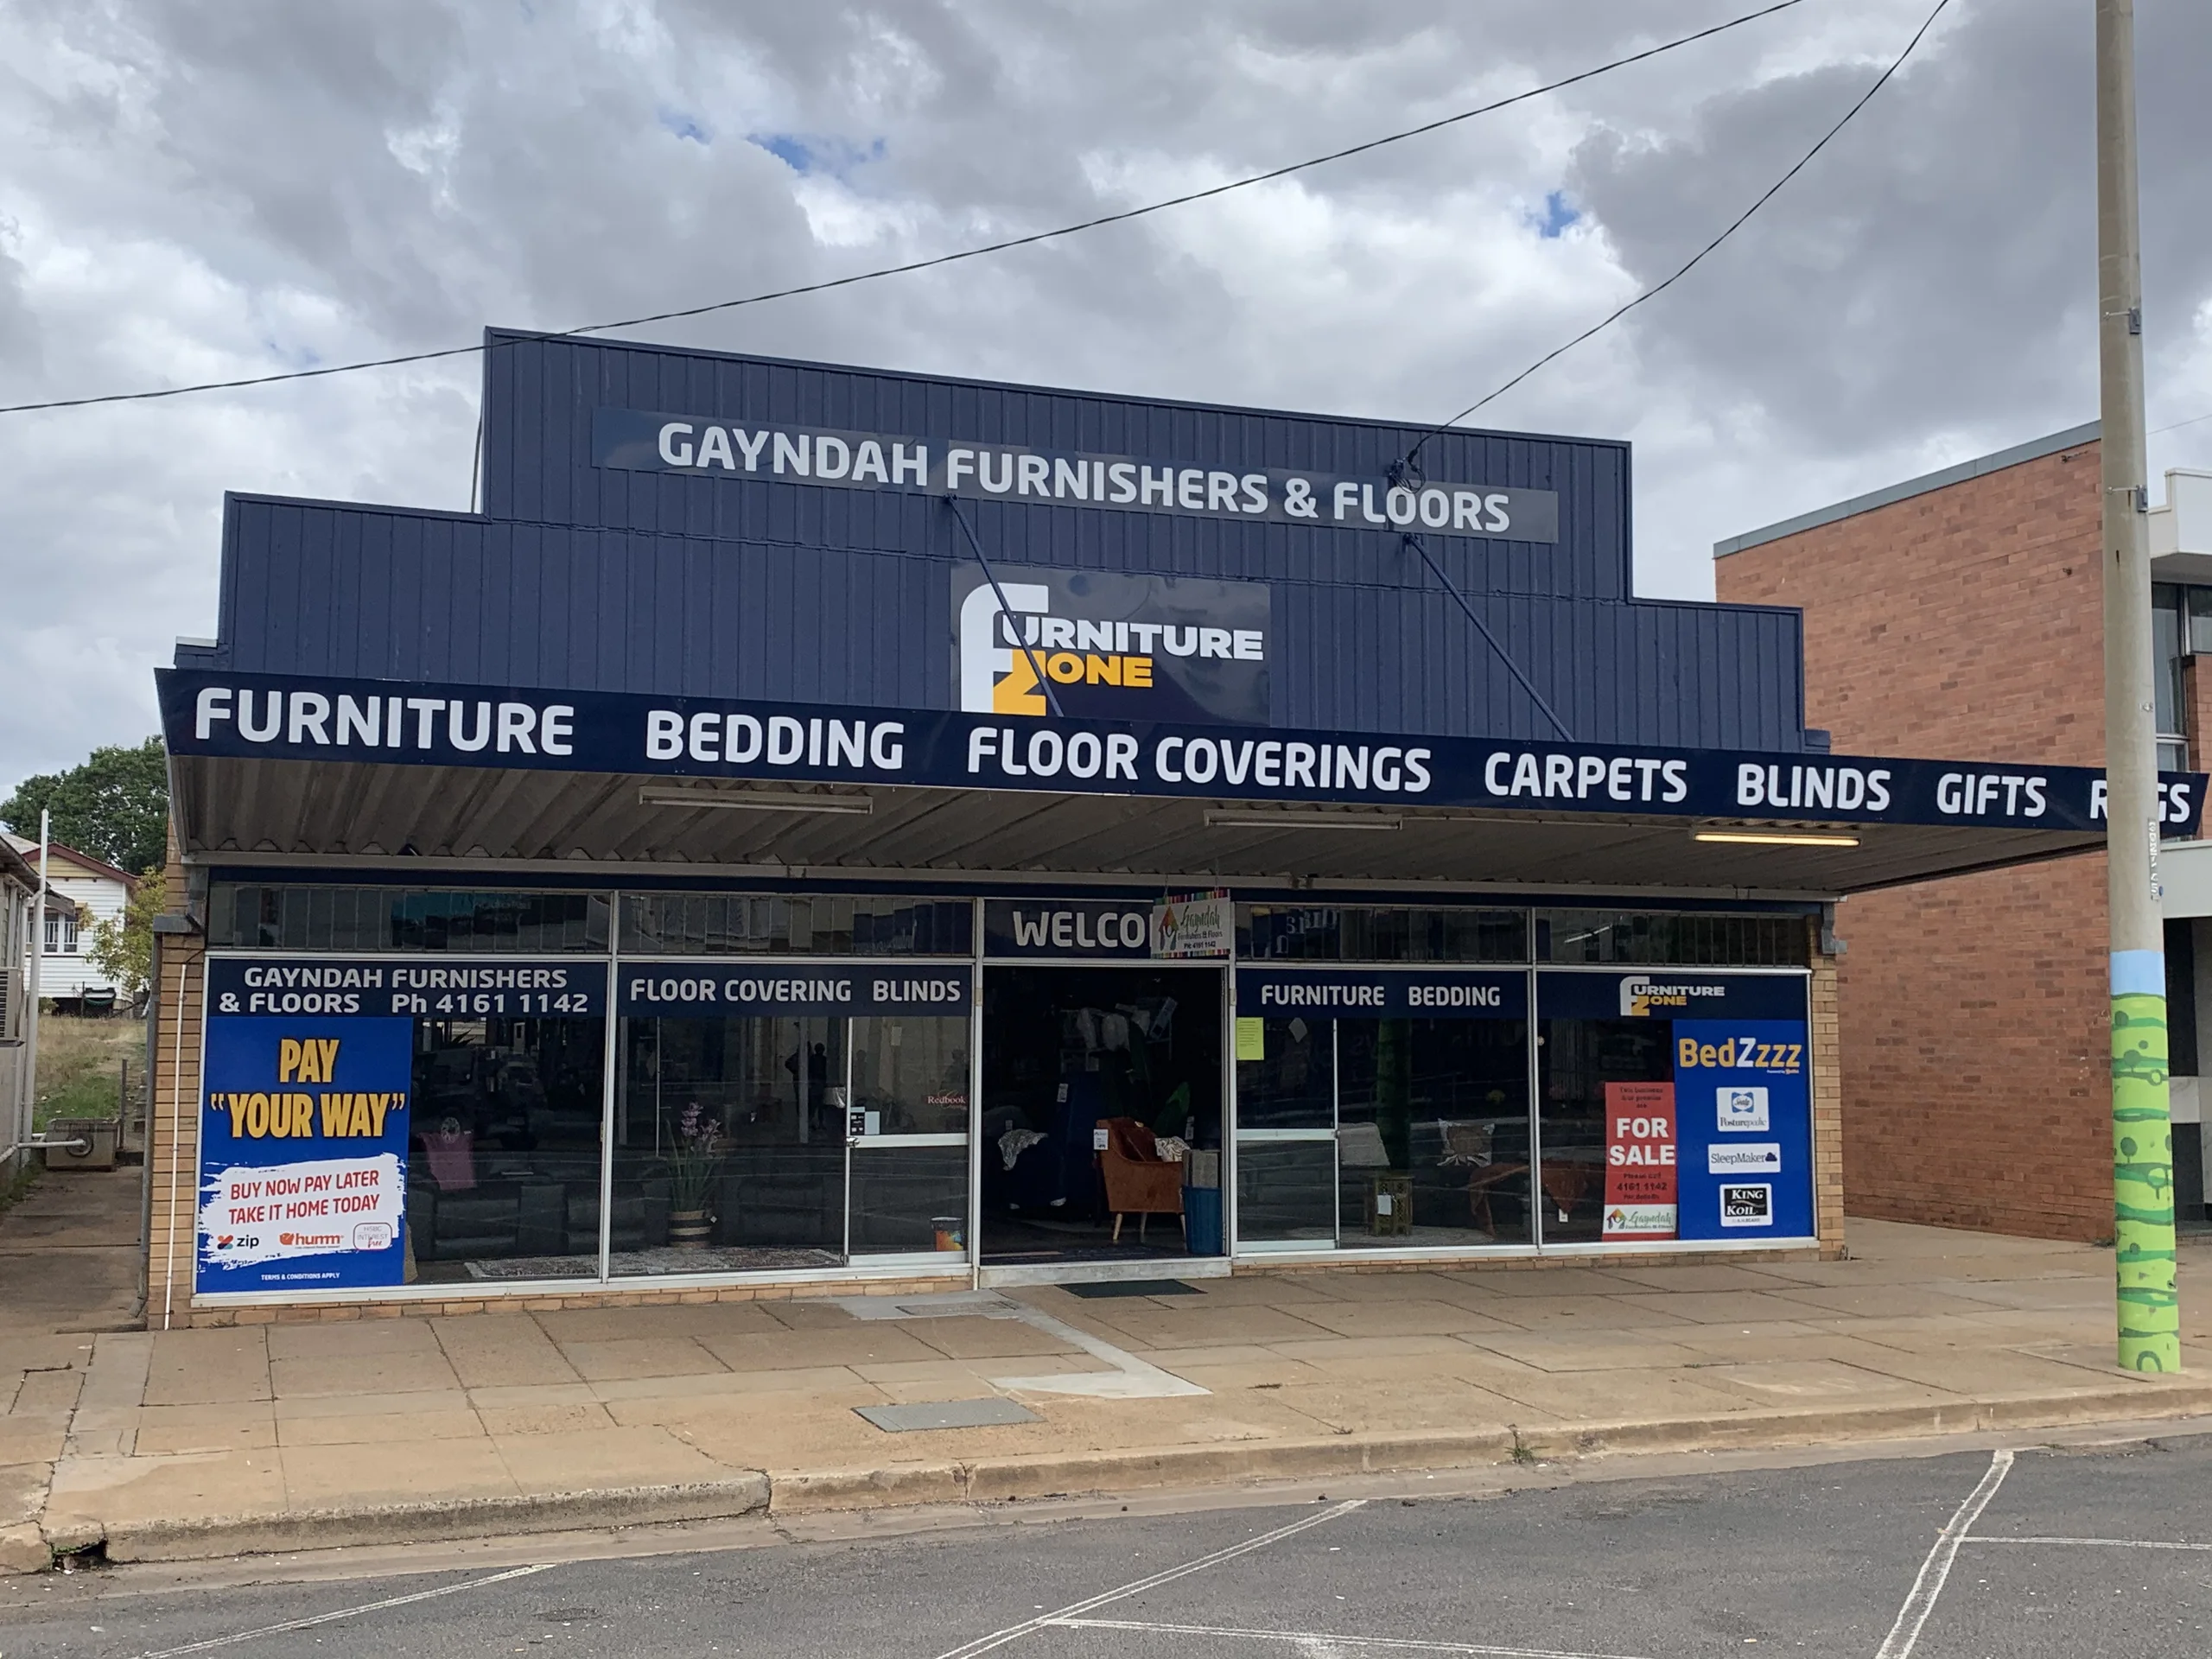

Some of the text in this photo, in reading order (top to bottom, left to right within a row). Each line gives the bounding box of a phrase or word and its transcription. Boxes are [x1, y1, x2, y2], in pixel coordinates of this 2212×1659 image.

[658, 423, 1511, 533] GAYNDAH FURNISHERS & FLOORS
[960, 582, 1263, 714] FURNITURE
[993, 648, 1153, 716] ZONE
[195, 687, 575, 755] FURNITURE
[646, 709, 905, 770] BEDDING
[968, 727, 1139, 780] FLOOR
[1155, 736, 1431, 792] COVERINGS
[1484, 752, 1688, 803] CARPETS
[1737, 763, 1891, 811] BLINDS
[1936, 772, 2047, 817] GIFTS
[1013, 911, 1152, 948] WELCO
[245, 967, 568, 988] GAYNDAH FURNISHERS
[630, 978, 961, 1002] FLOOR COVERING BLINDS
[1262, 984, 1501, 1007] FURNITURE BEDDING
[1620, 976, 1725, 1016] FURNITURE
[219, 992, 588, 1014] & FLOORS Ph 4161 1142
[1631, 995, 1687, 1016] ZONE
[279, 1038, 340, 1084] PAY
[1679, 1038, 1802, 1067] BedZzzz
[927, 1096, 966, 1104] Redbook
[1617, 1117, 1669, 1139] FOR
[1720, 1116, 1766, 1128] Posturepedic
[1609, 1144, 1675, 1166] SALE
[1711, 1153, 1765, 1165] SleepMaker
[230, 1169, 379, 1200] BUY NOW PAY LATER
[1732, 1190, 1764, 1200] KING
[229, 1195, 379, 1225] TAKE IT HOME TODAY
[1726, 1205, 1756, 1216] KOIL
[237, 1234, 259, 1249] zip
[296, 1233, 340, 1245] humm
